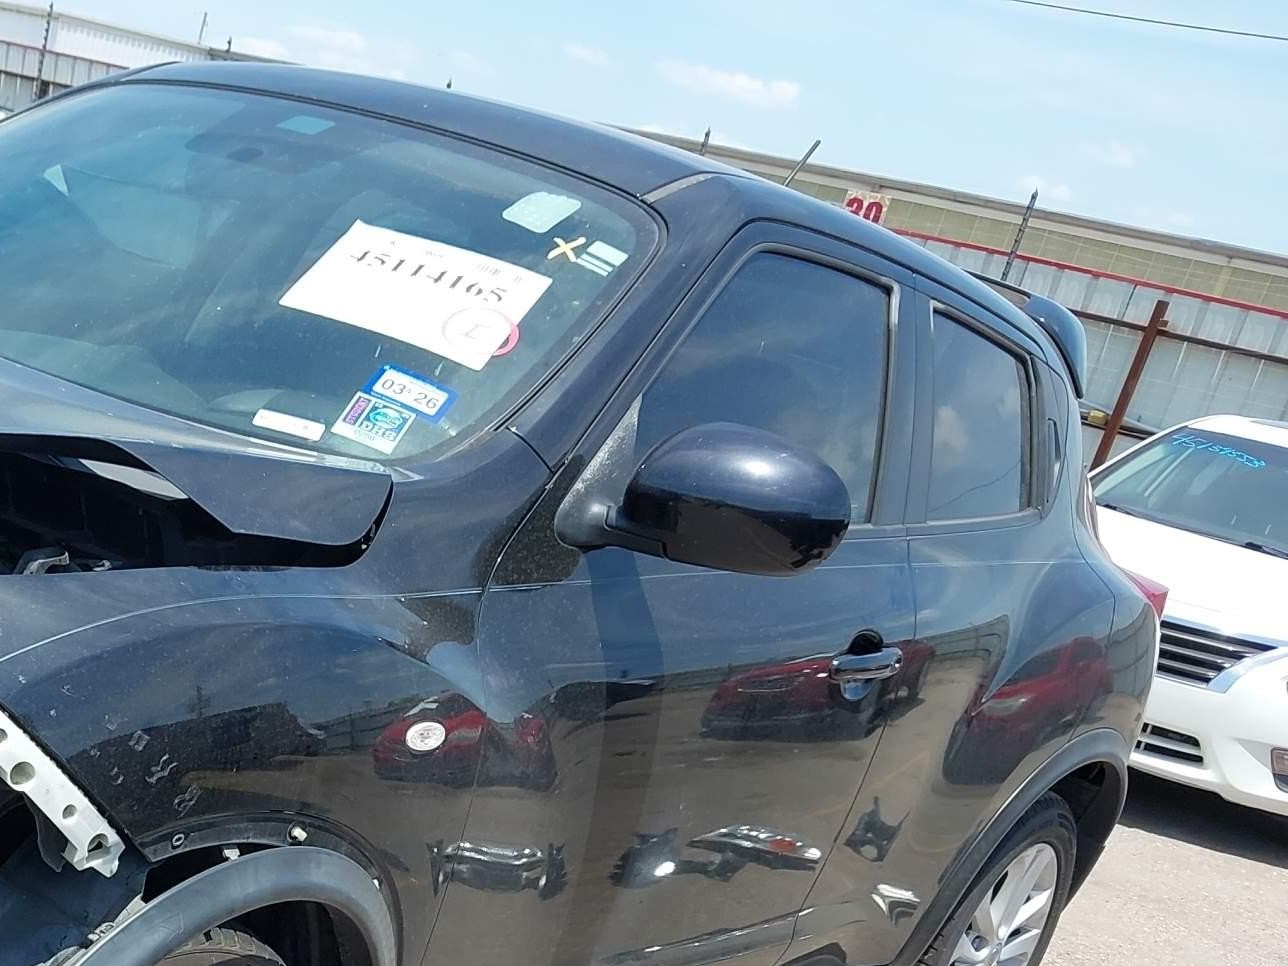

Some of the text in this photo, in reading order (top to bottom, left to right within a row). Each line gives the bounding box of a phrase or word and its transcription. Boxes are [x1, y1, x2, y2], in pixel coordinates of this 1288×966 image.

[349, 247, 508, 304] 45114165
[381, 378, 440, 410] 03 26
